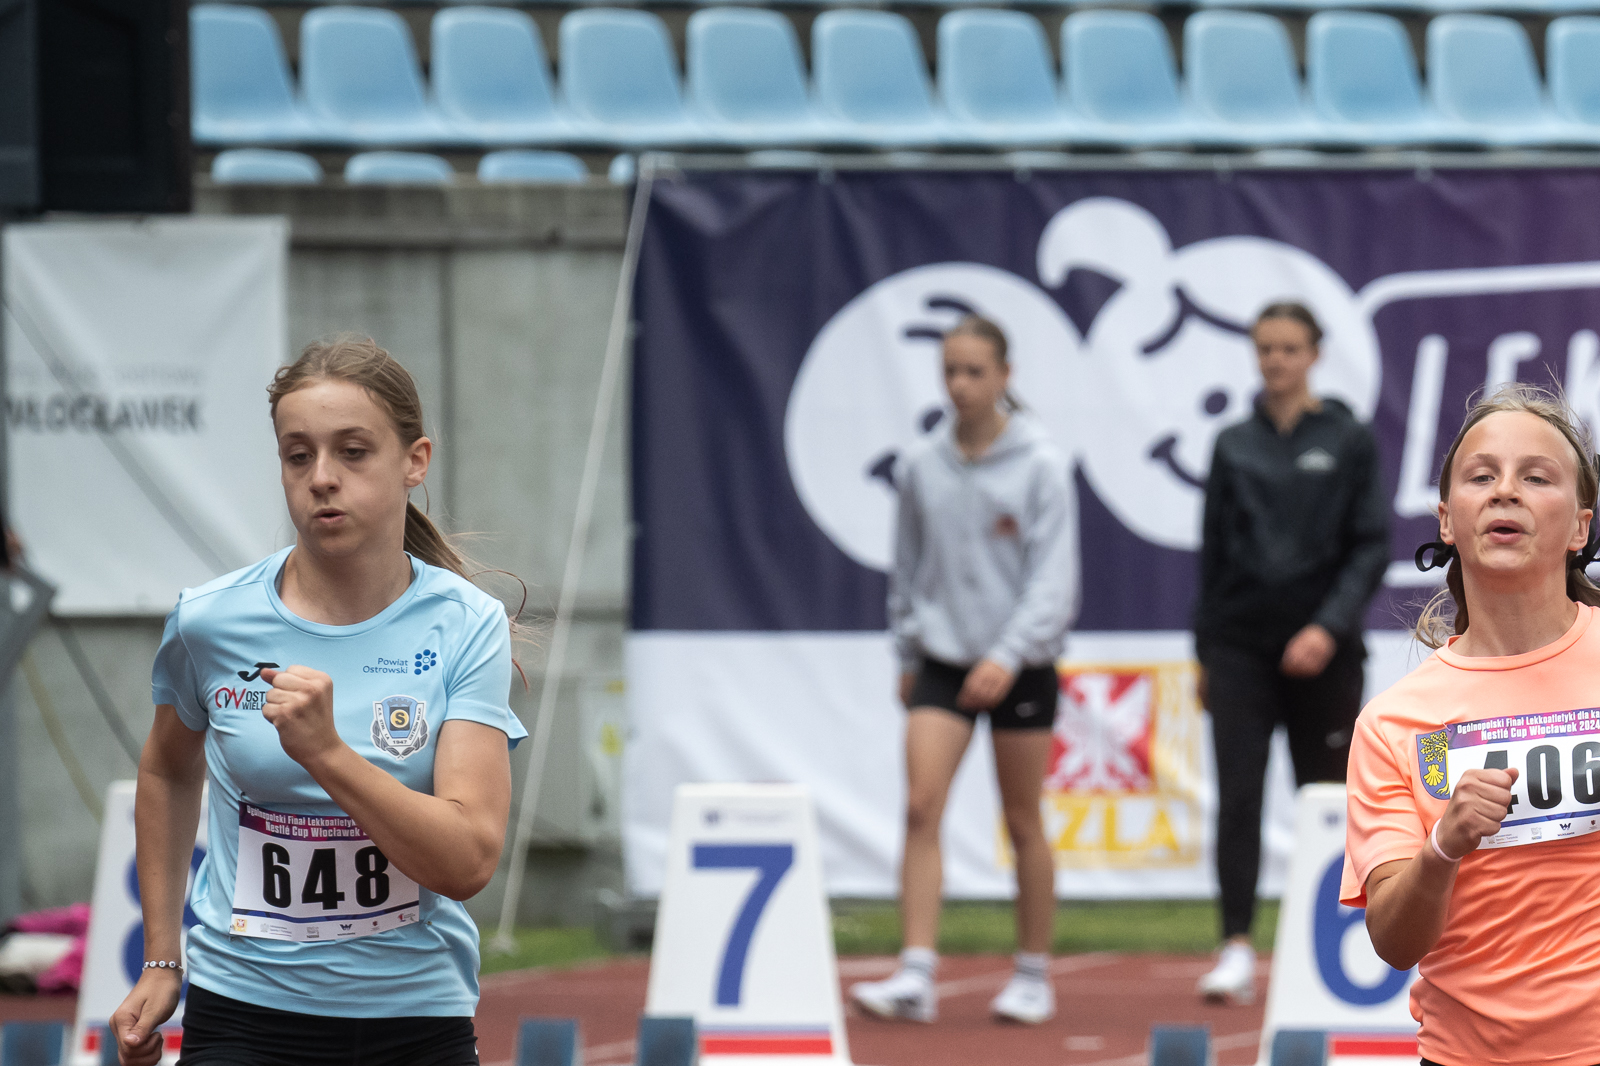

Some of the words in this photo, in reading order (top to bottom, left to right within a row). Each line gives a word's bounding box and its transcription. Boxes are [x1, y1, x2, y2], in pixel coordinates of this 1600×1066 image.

[362, 665, 408, 674] Ostrowski
[377, 657, 409, 666] Powiat
[245, 690, 266, 702] OST
[1457, 718, 1505, 734] Ogólnopolski
[1505, 716, 1524, 727] Finał
[1526, 711, 1576, 726] Lekkoatletyki
[1577, 710, 1589, 720] dla
[1481, 727, 1509, 741] Nestlé
[1510, 727, 1528, 739] Cup
[1529, 721, 1577, 736] Włocławek
[1579, 719, 1600, 732] 2024
[246, 804, 286, 824] Ogólnopolski
[287, 815, 306, 827] Finał
[307, 817, 357, 828] Lekkoatletyk
[265, 820, 290, 835] Nestlé
[292, 826, 309, 838] Cup
[310, 827, 361, 838] Włocławek
[262, 842, 390, 910] 648
[692, 843, 794, 1007] 7
[1313, 851, 1412, 1007] 6
